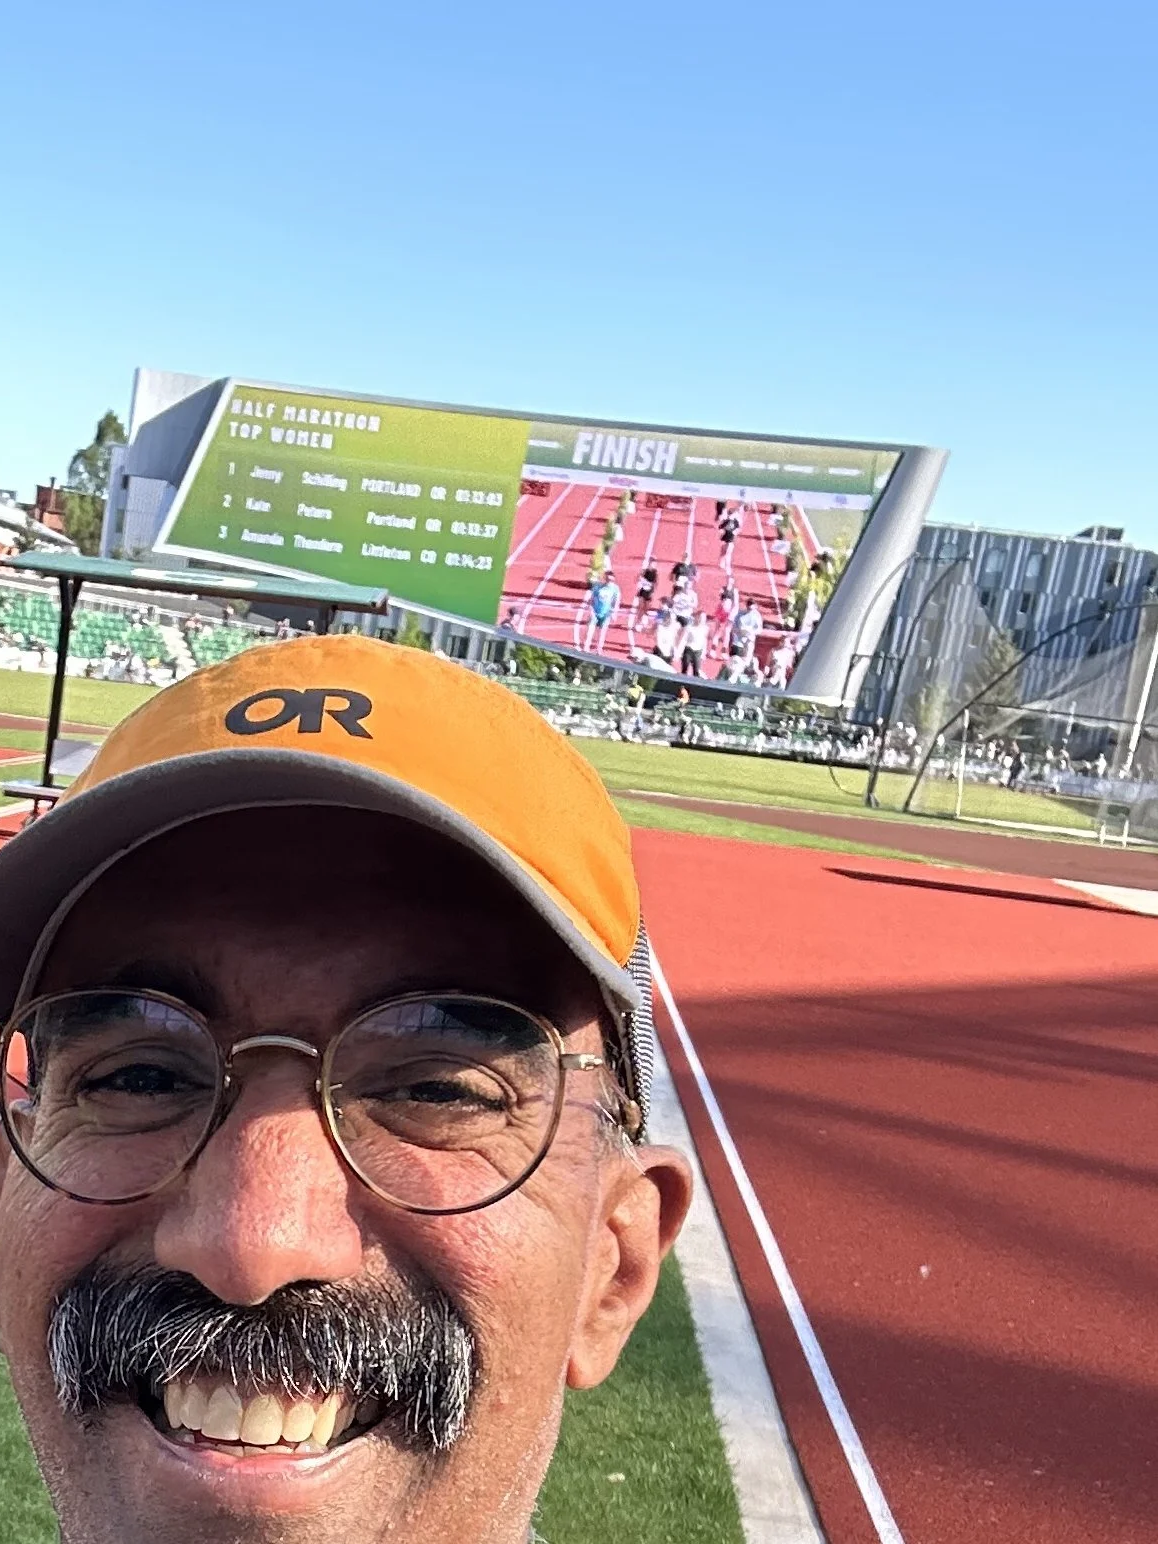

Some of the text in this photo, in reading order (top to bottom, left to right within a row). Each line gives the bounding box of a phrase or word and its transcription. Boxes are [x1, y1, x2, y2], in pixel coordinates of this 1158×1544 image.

[230, 399, 381, 432] HALF MARATHON
[228, 421, 334, 450] TOP WOMEN
[572, 432, 679, 474] FINISH
[222, 494, 233, 508] 2
[218, 525, 228, 539] 3
[225, 689, 373, 739] OR
